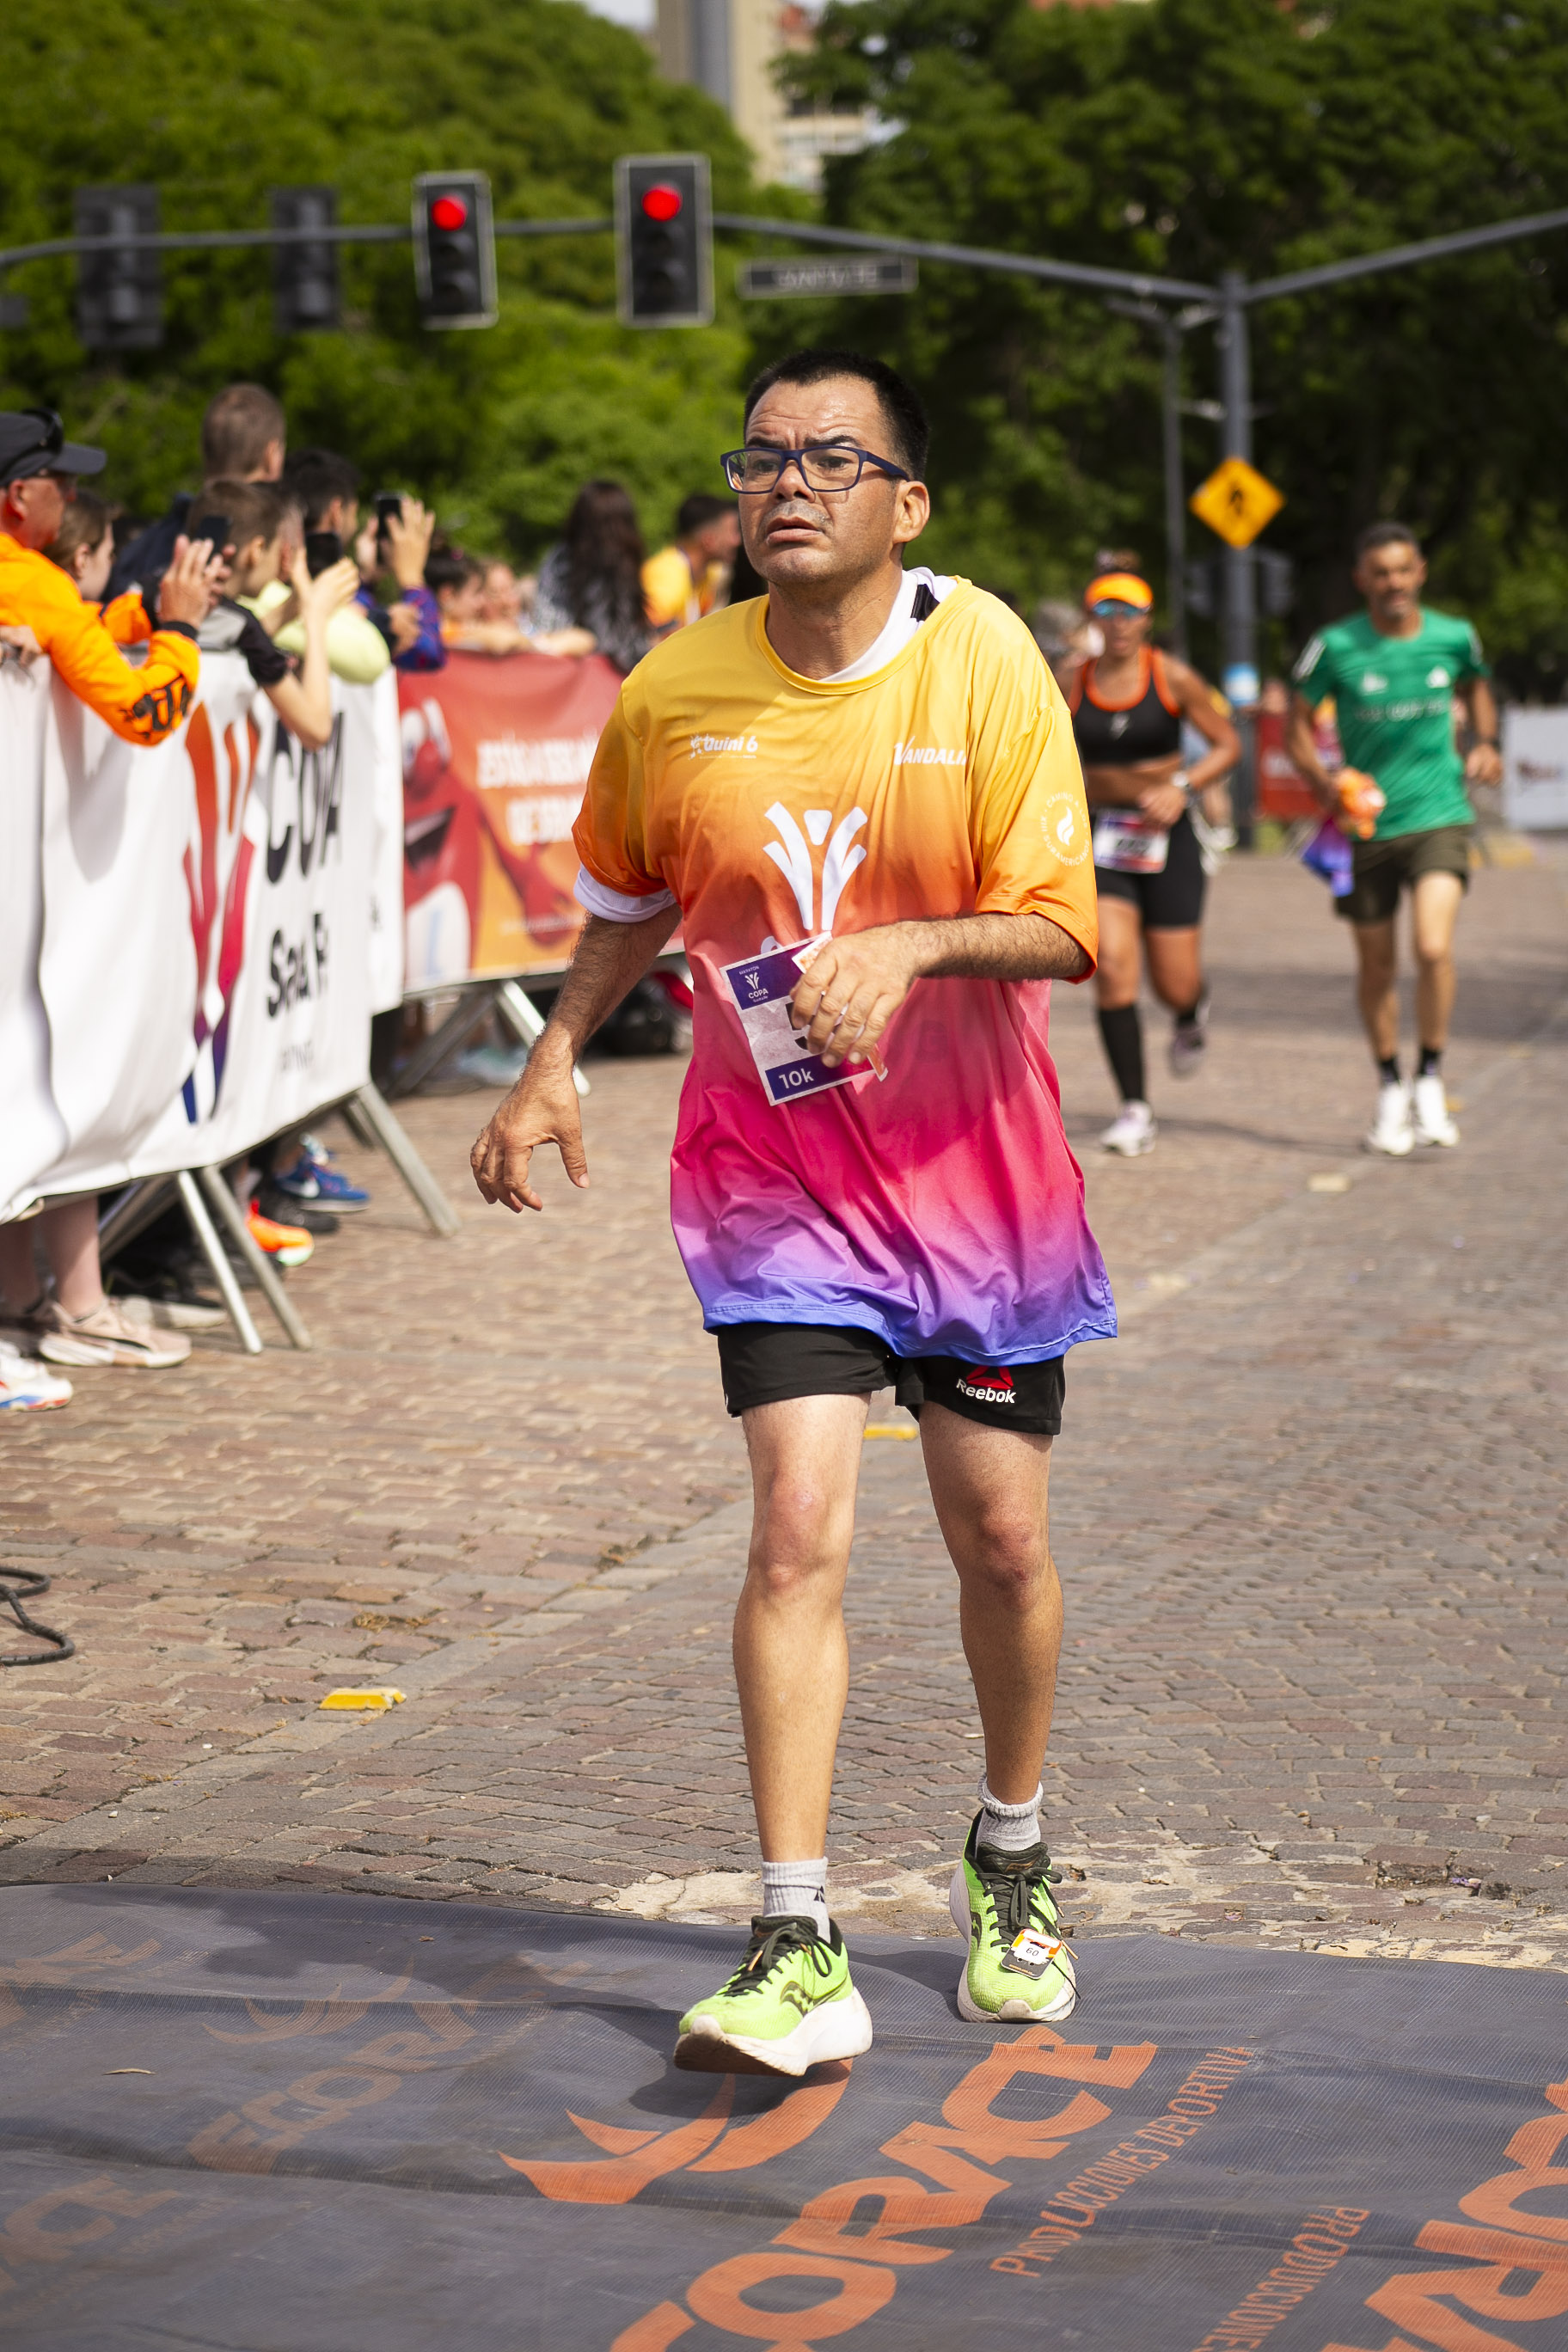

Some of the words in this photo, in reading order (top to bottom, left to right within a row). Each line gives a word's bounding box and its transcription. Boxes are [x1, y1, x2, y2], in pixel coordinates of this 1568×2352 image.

[746, 735, 758, 752] 6
[748, 988, 769, 999] COPA
[779, 1068, 815, 1089] 10k
[956, 1378, 1017, 1404] Reebok
